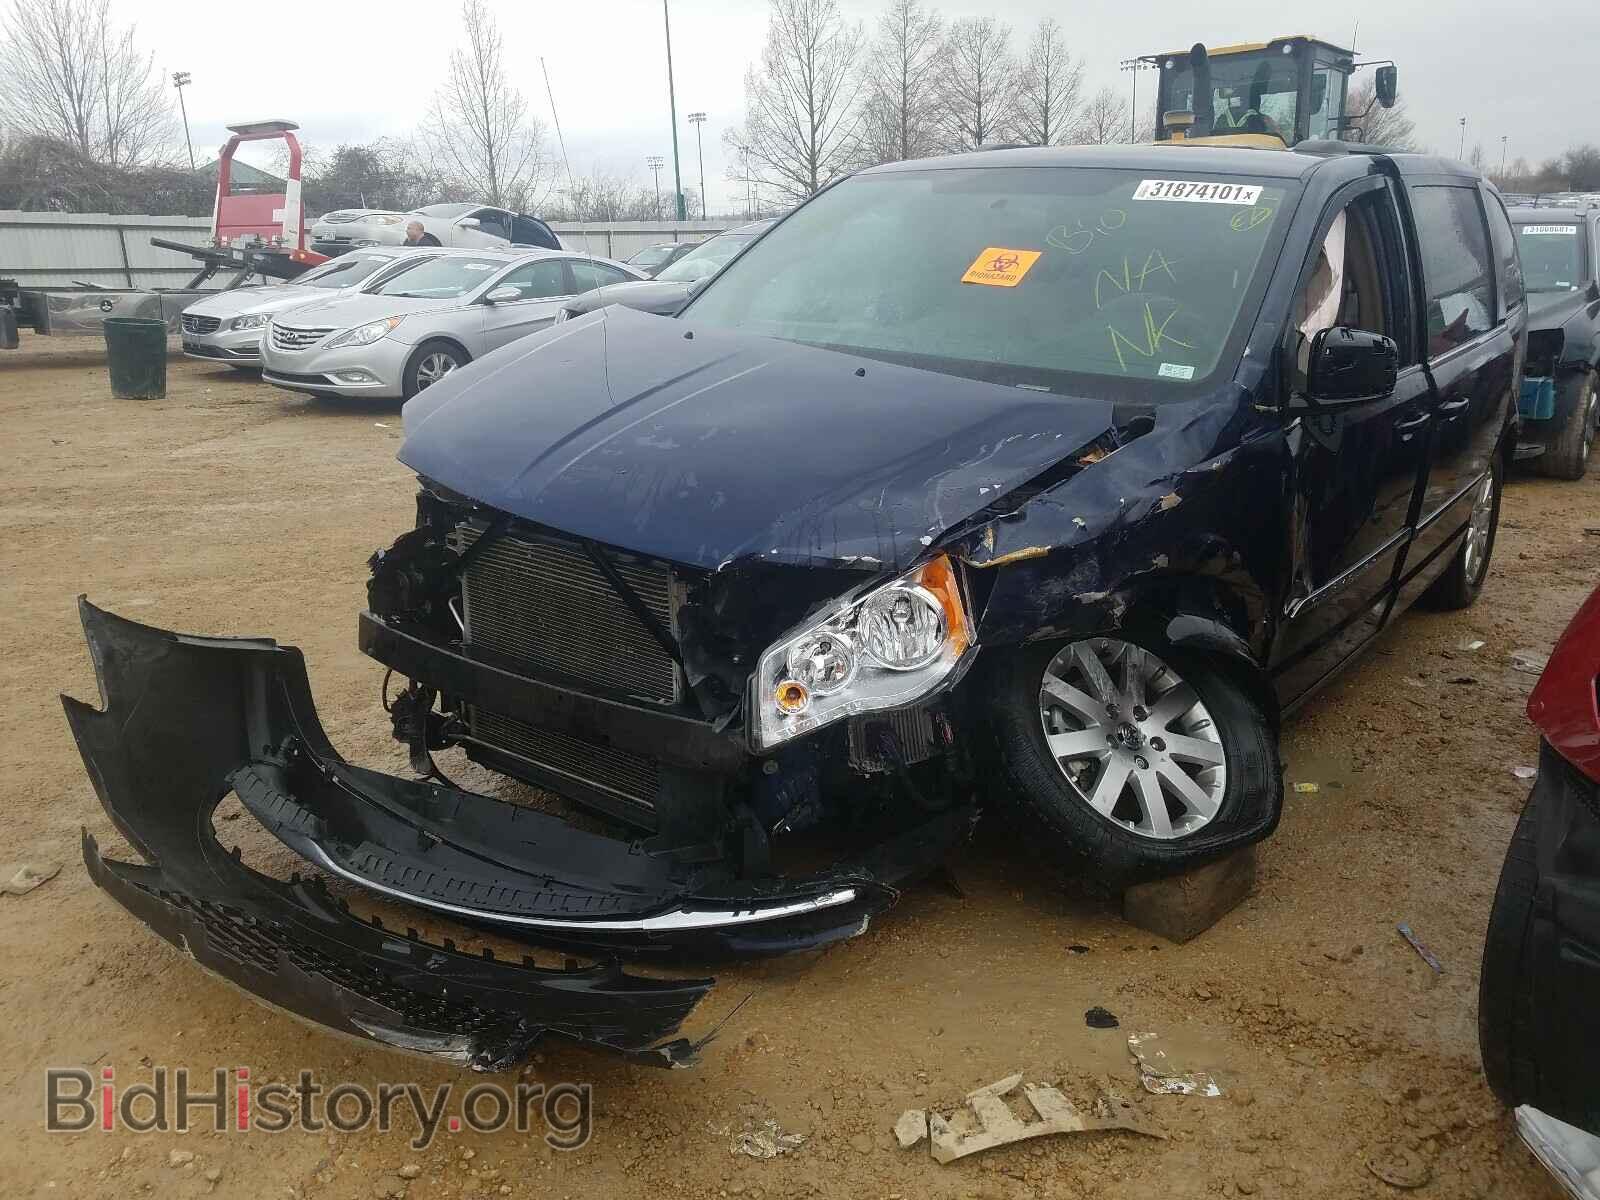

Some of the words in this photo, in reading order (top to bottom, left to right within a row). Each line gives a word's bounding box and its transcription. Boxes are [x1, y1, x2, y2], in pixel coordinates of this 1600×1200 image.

[969, 270, 1017, 281] BIOHAZARD
[1096, 248, 1179, 310] NA
[1108, 302, 1198, 373] NK
